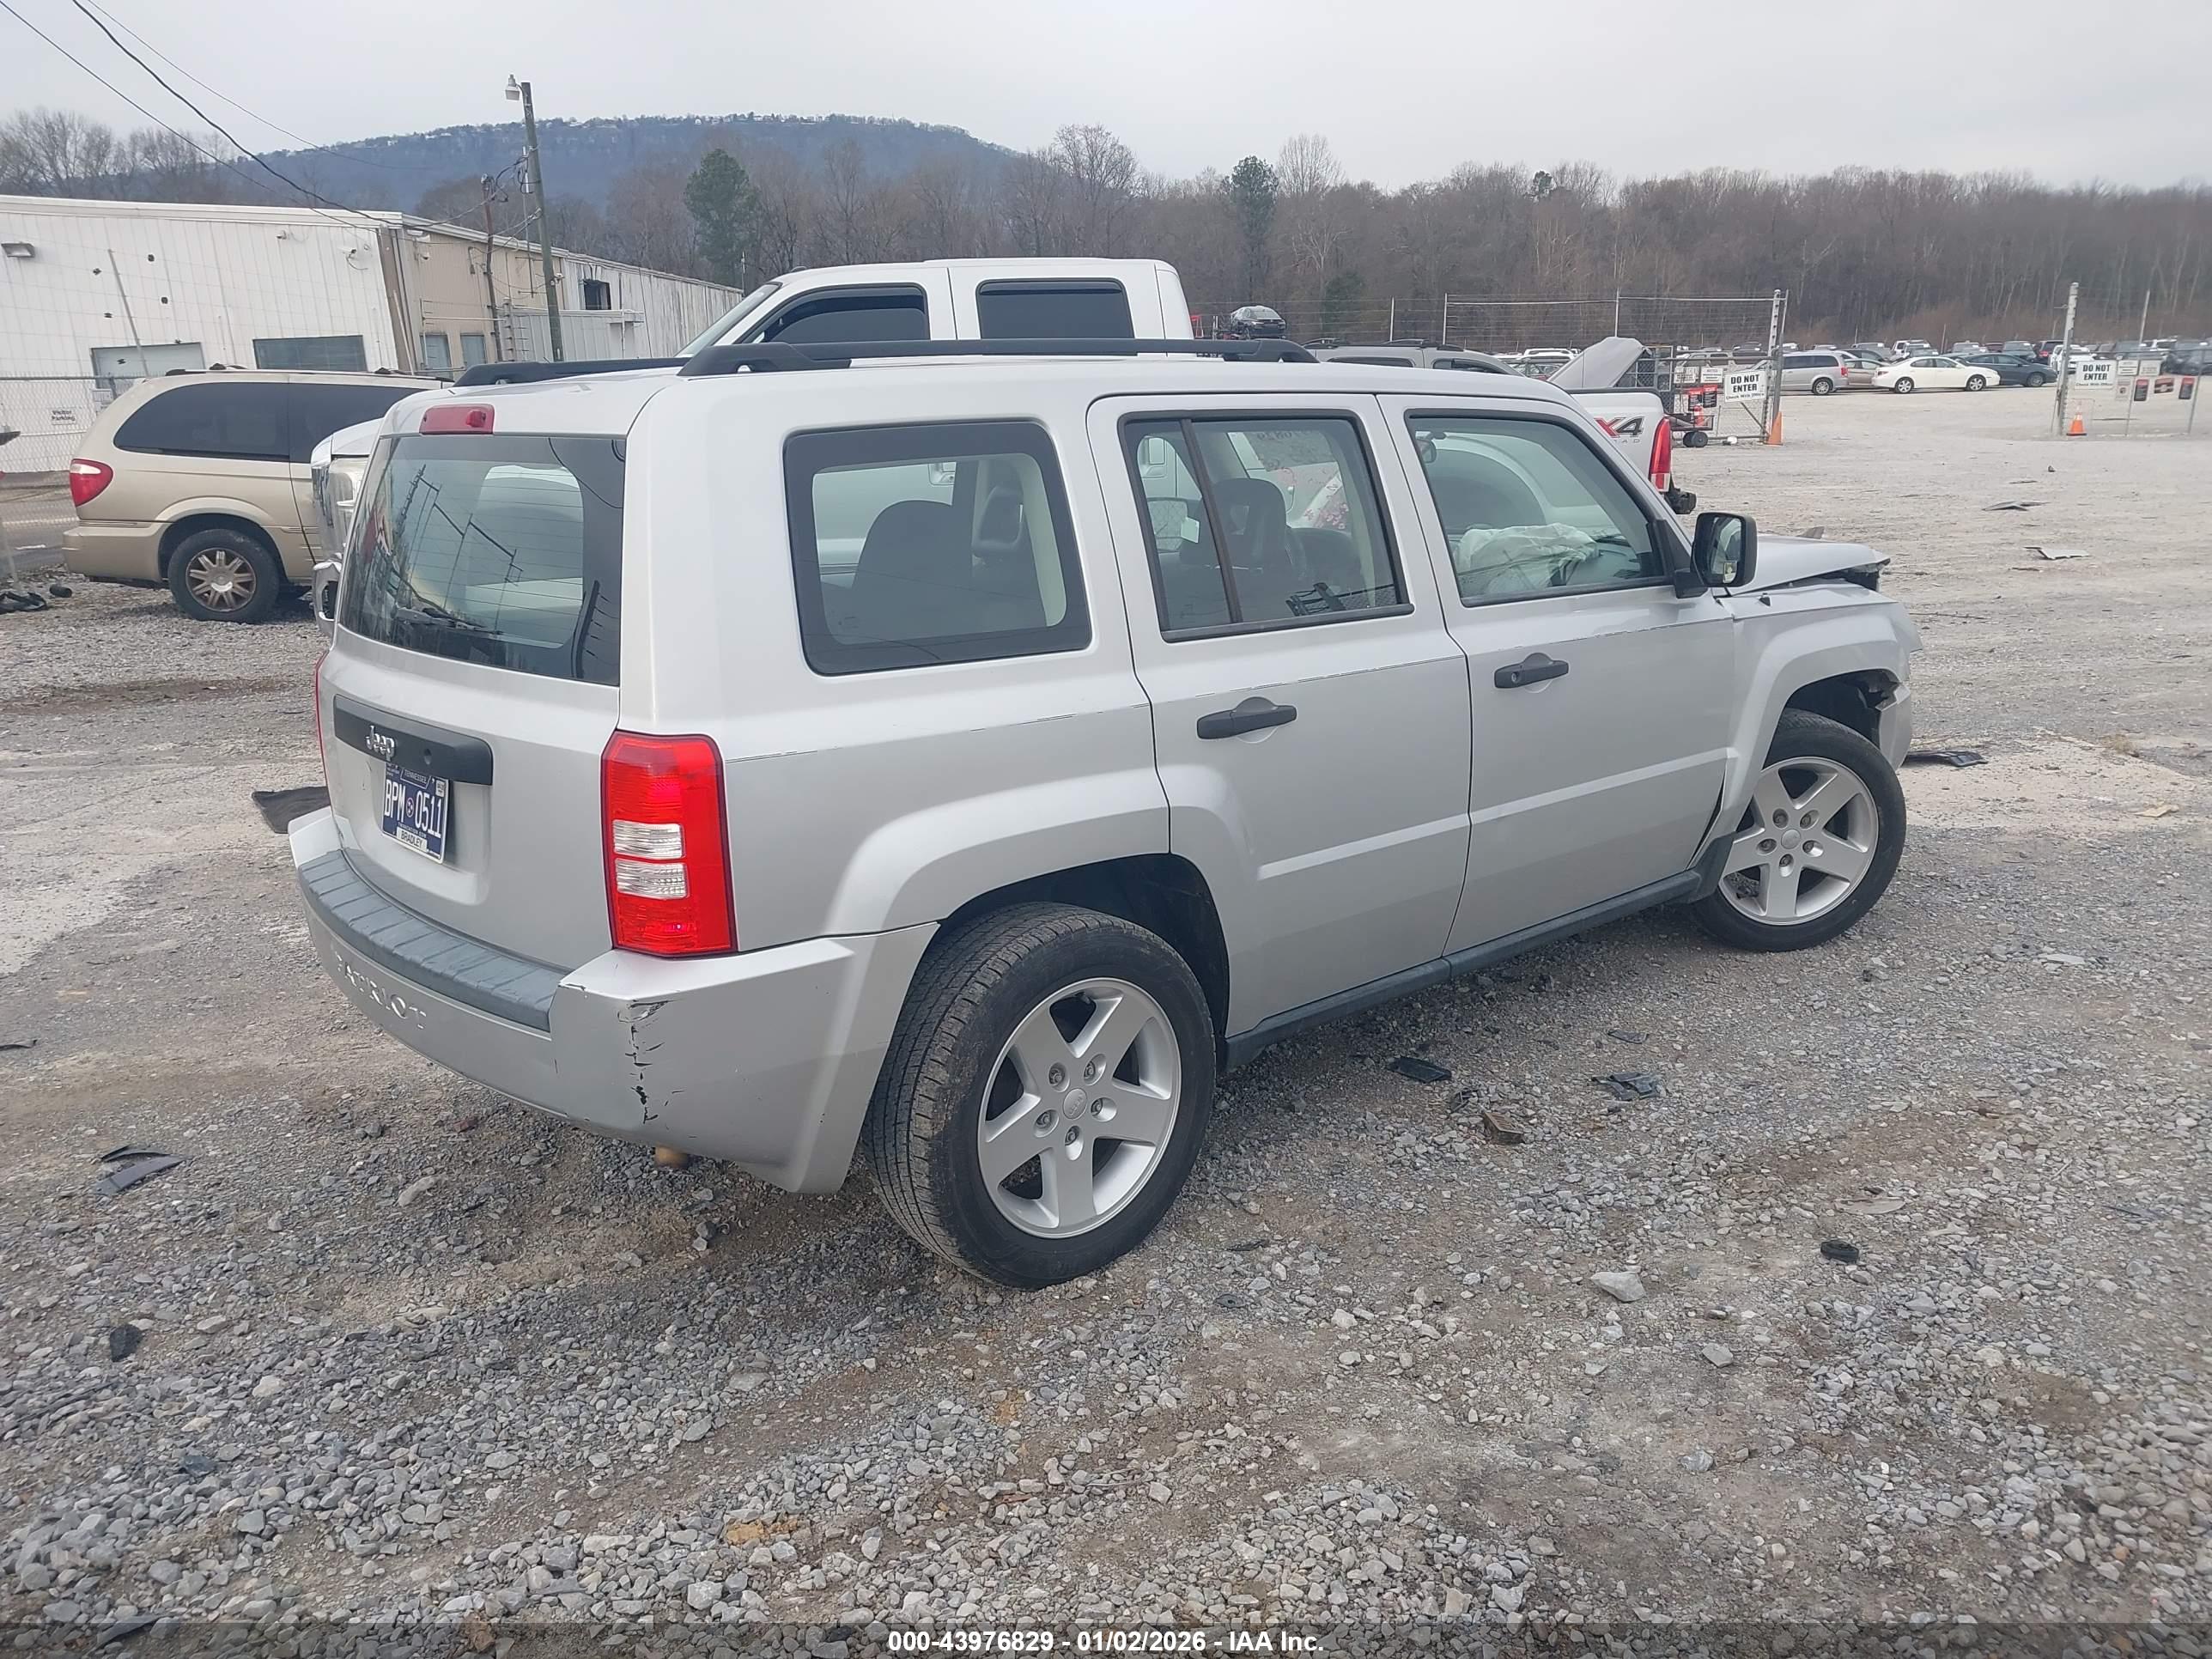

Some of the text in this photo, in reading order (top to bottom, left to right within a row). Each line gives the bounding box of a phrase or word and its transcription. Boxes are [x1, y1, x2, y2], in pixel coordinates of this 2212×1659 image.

[1730, 374, 1759, 385] DO NOT
[1733, 383, 1757, 393] ENTER
[1593, 416, 1644, 438] X4
[365, 725, 395, 762] Jeep
[384, 779, 442, 839] BPM 0511
[401, 830, 423, 848] BRADLEY
